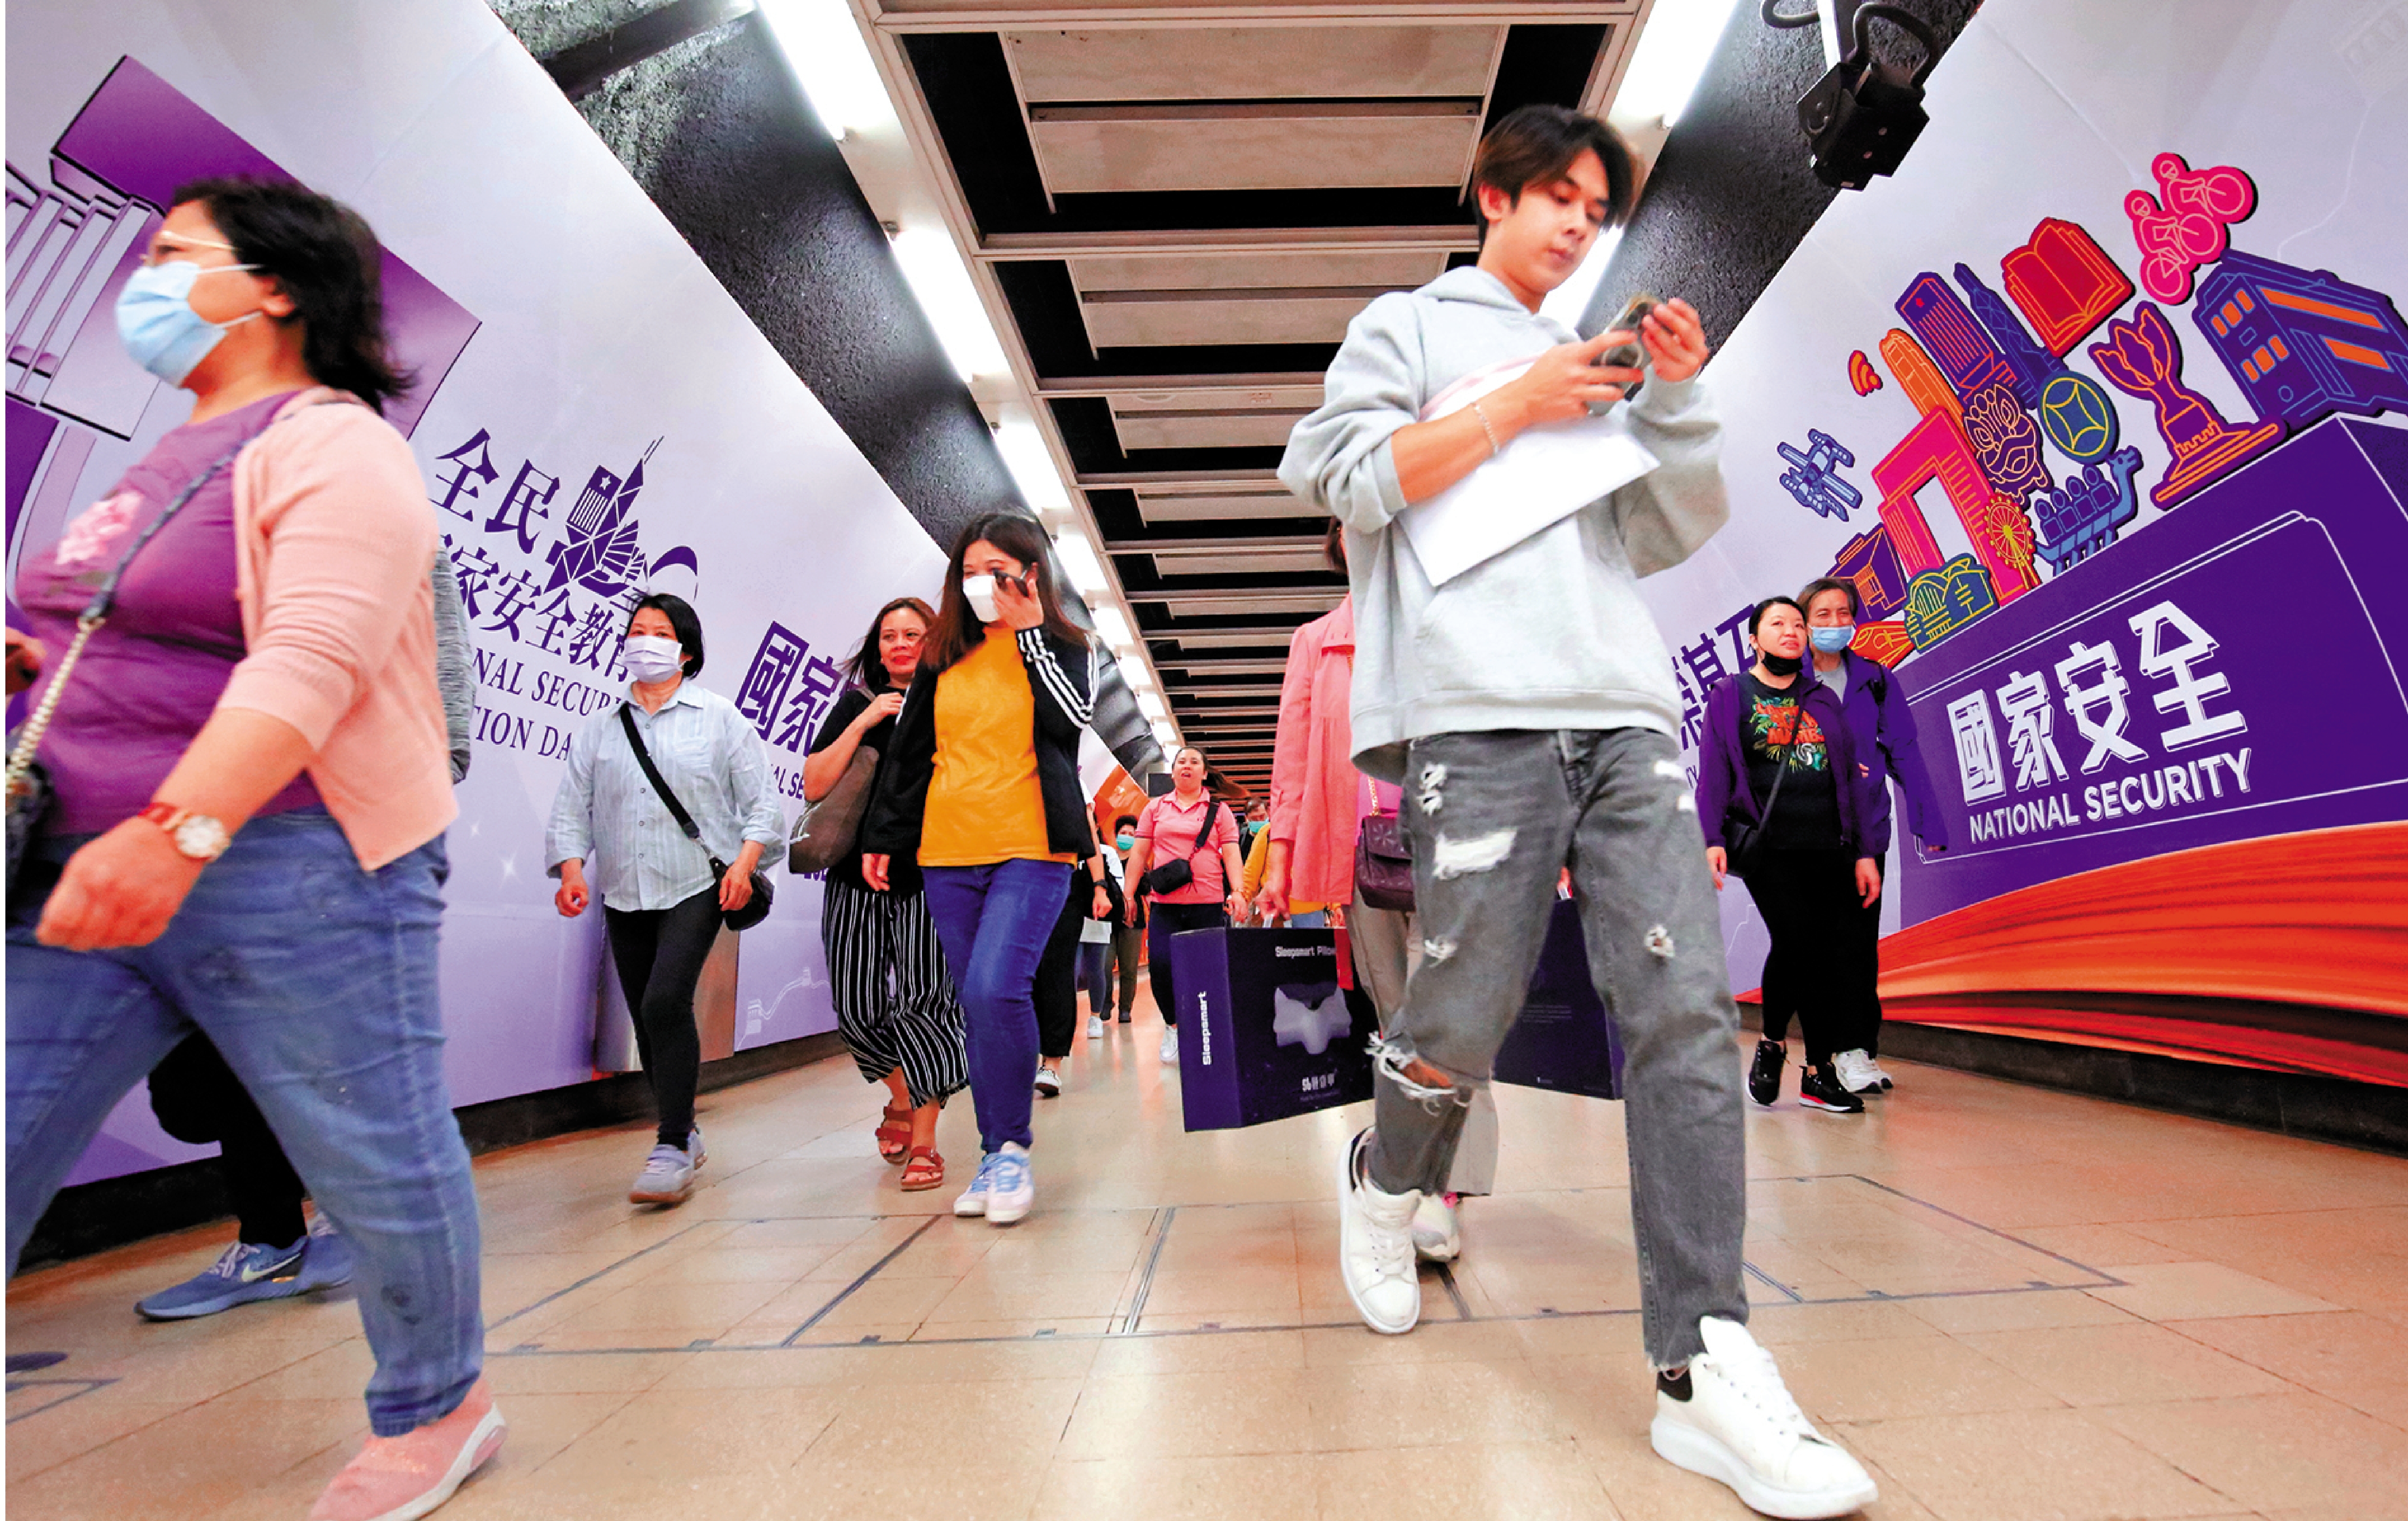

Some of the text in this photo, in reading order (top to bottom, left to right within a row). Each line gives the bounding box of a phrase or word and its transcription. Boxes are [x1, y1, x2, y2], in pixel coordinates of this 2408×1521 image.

[427, 427, 561, 554] 全民
[440, 533, 628, 682] 家安全教育
[1947, 600, 2248, 807] 國家安全
[1969, 747, 2252, 844] NATIONAL SECURITY
[1197, 991, 1212, 1065] Sleepsmart
